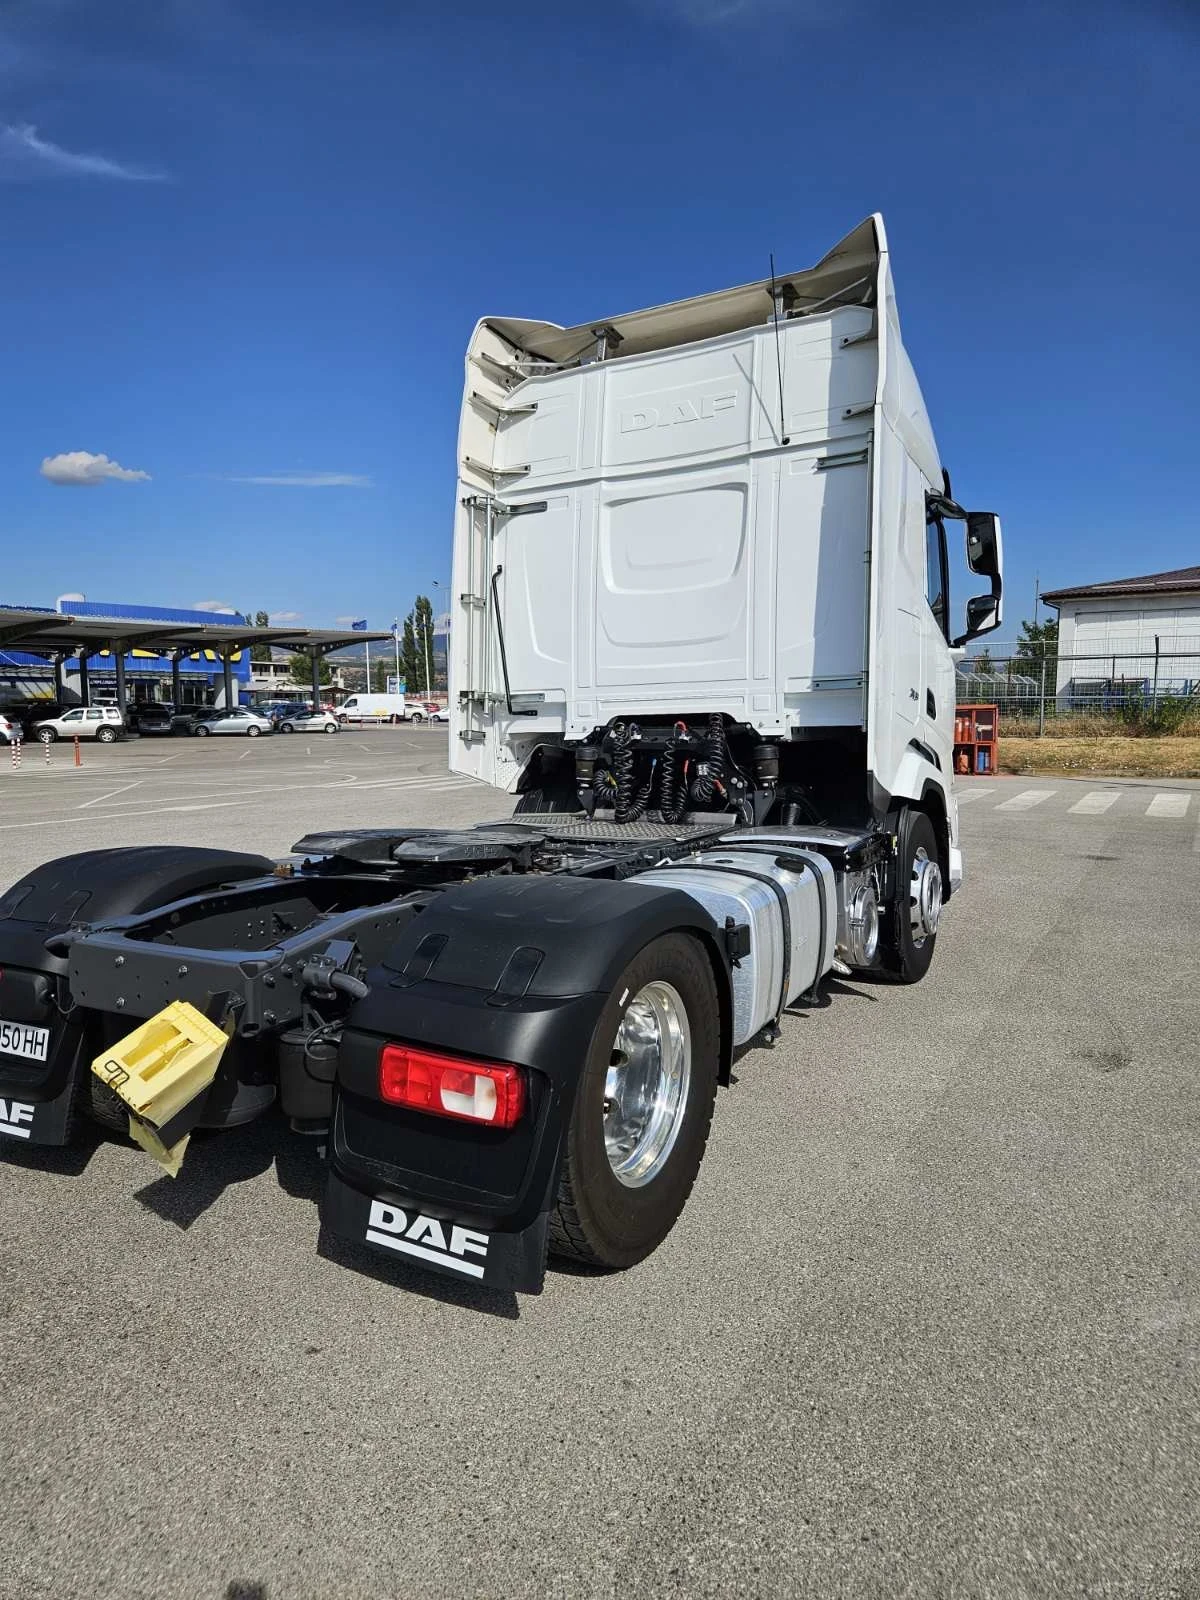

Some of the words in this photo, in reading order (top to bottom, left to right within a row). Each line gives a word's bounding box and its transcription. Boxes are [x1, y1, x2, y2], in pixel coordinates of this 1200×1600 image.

[619, 391, 737, 433] DAF
[0, 1023, 21, 1050] 50
[368, 1199, 490, 1256] DAF
